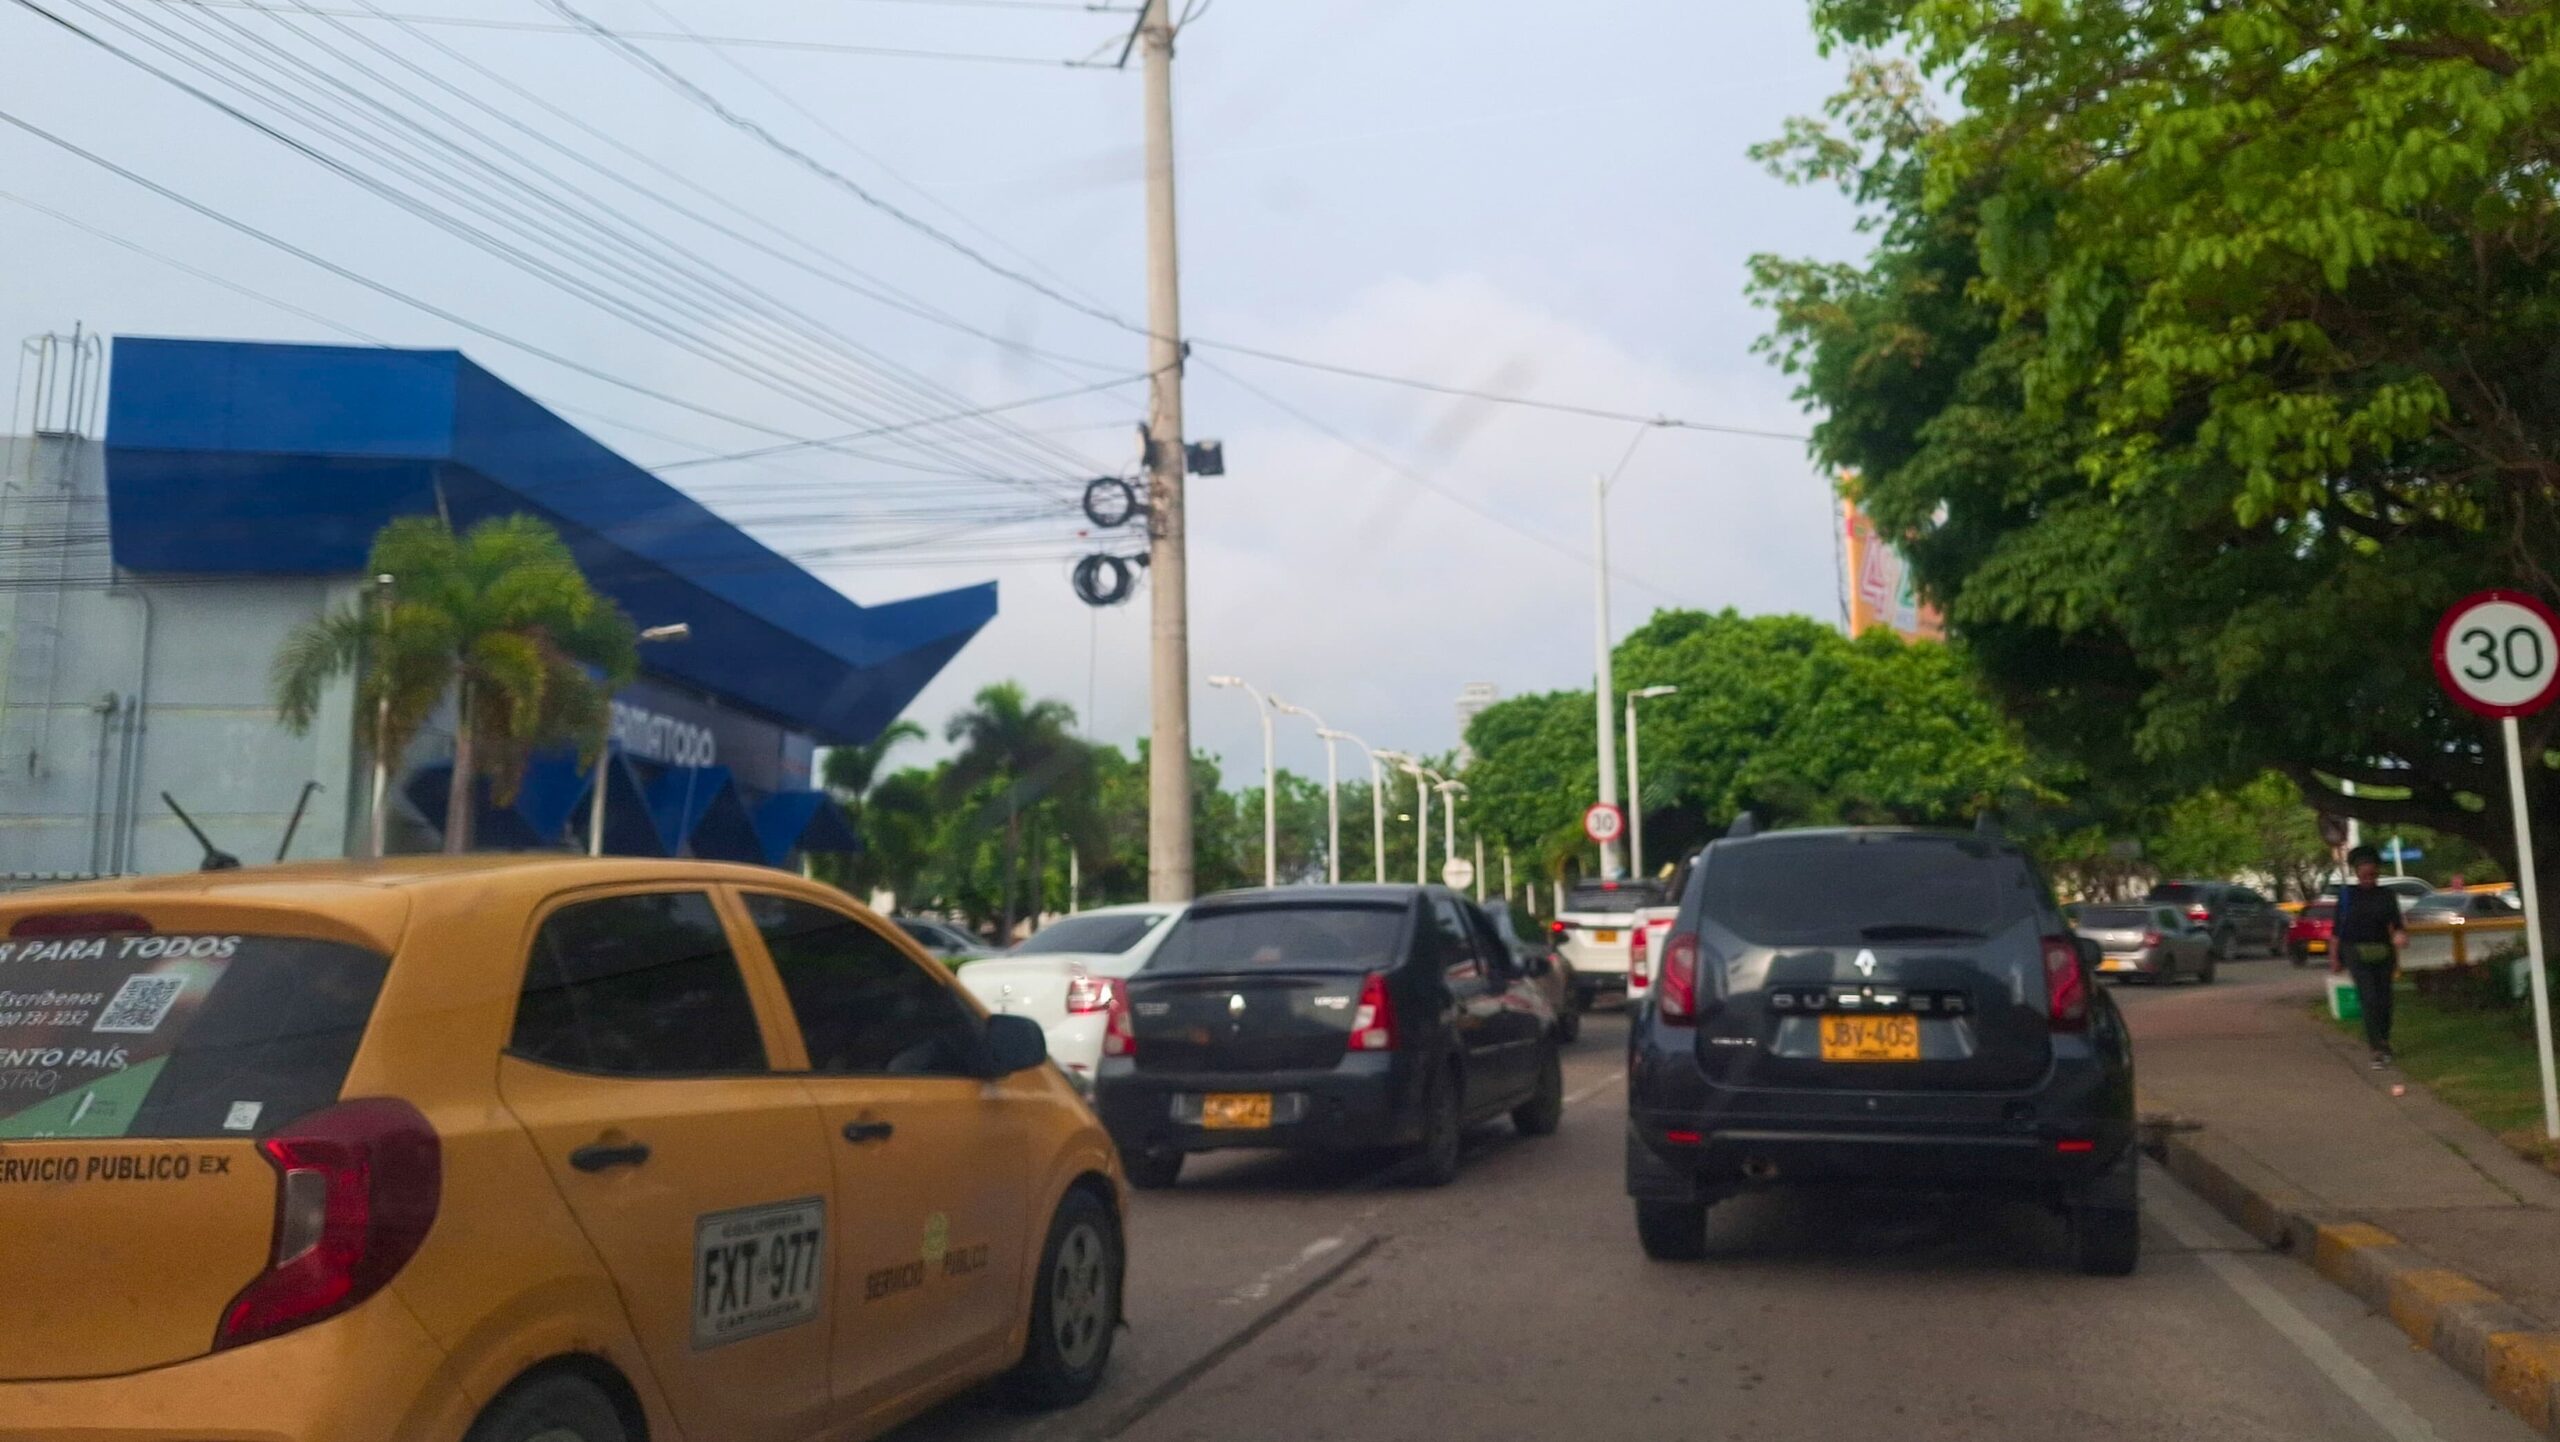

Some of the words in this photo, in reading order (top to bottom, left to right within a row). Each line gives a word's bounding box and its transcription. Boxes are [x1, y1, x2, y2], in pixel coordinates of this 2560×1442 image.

[2461, 625, 2544, 681] 30
[17, 938, 107, 962] PARA
[119, 936, 242, 960] TODOS
[86, 1155, 191, 1180] PUBLICO
[198, 1155, 232, 1174] EX
